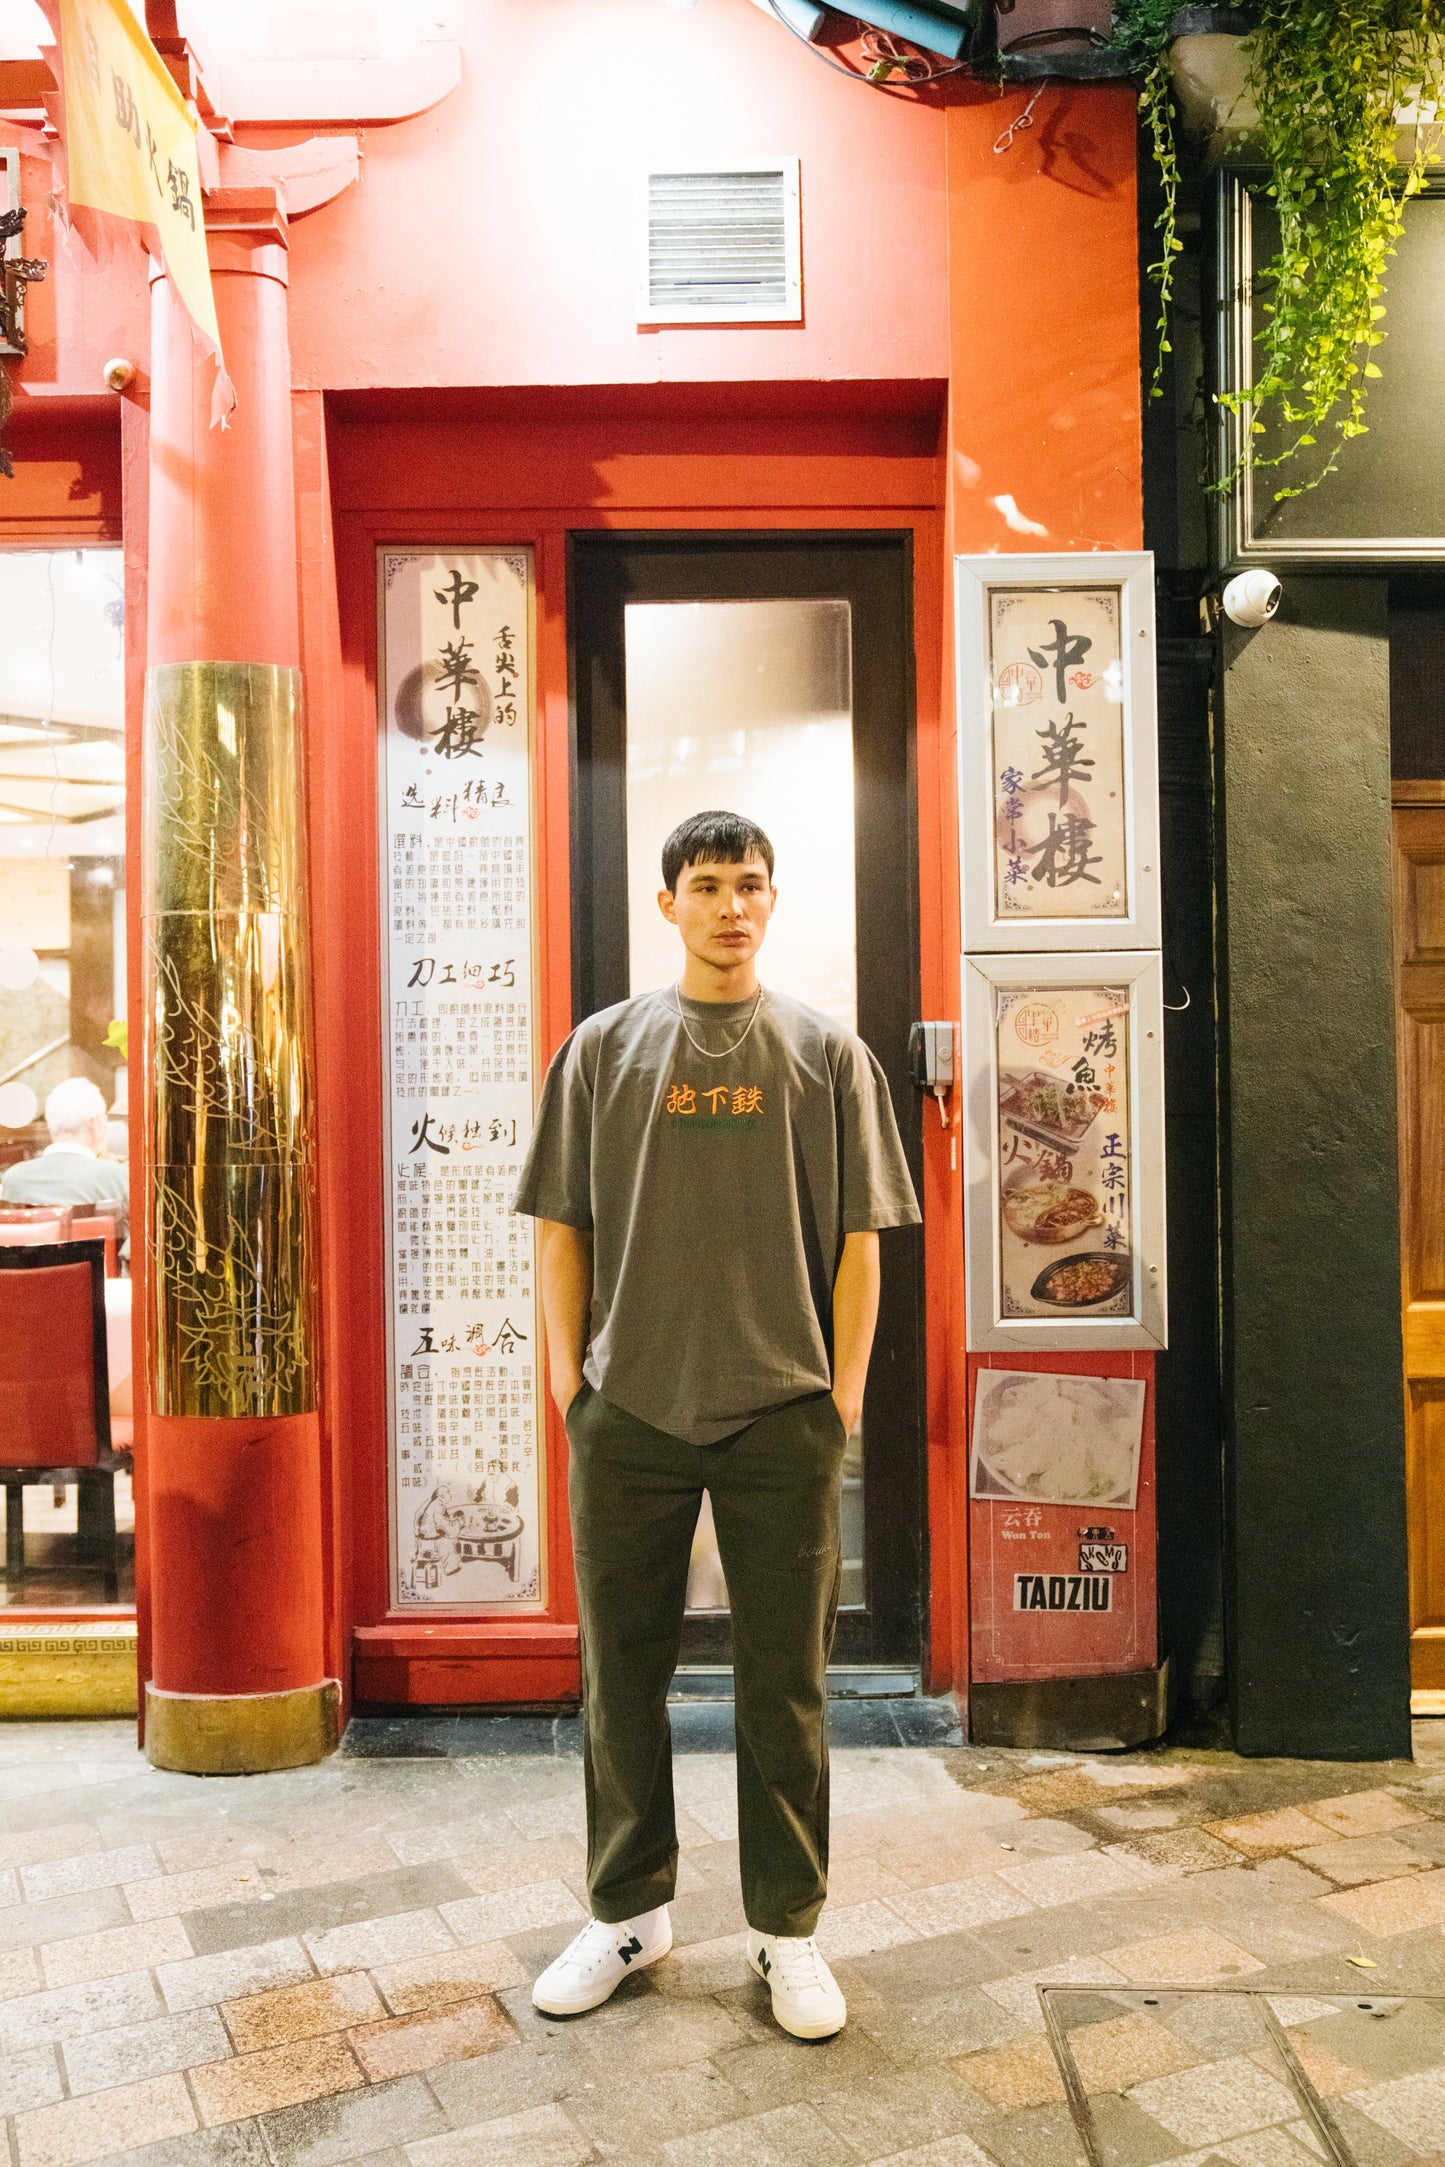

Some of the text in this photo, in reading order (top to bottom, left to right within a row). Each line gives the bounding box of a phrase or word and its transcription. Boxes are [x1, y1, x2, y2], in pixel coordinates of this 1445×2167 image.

[430, 569, 484, 759] 中華樓
[493, 625, 519, 727] 舌尖上的
[1025, 619, 1103, 888] 中華樓
[999, 766, 1028, 886] 家常小菜
[1066, 1019, 1117, 1094] 烤魚
[1003, 1135, 1073, 1182] 火鍋
[1100, 1133, 1131, 1250] 正宗川菜
[1001, 1507, 1042, 1528] 云吞
[1002, 1530, 1051, 1540] Won Ton
[1017, 1575, 1109, 1611] TADZIU
